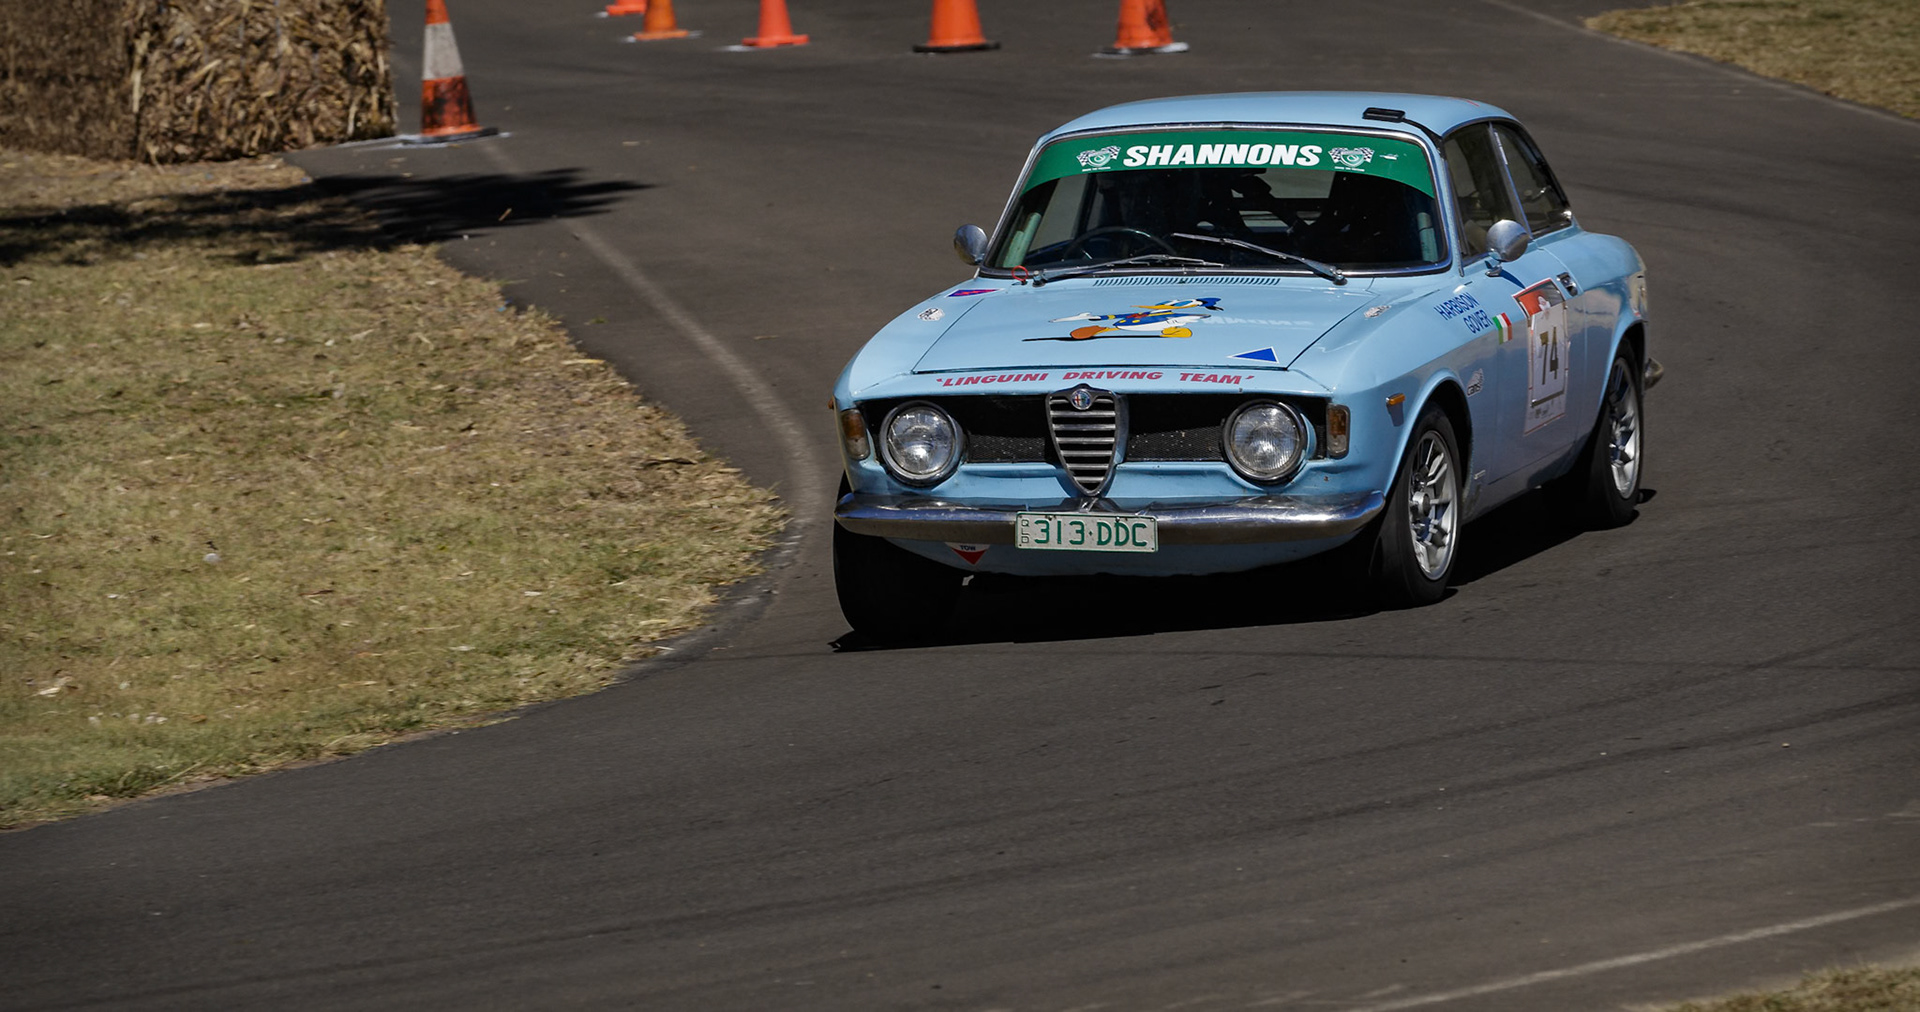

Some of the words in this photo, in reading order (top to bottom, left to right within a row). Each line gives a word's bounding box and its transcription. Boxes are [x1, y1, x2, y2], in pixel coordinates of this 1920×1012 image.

[1123, 144, 1323, 167] SHANNONS
[1433, 291, 1481, 321] HARBISON
[1462, 309, 1494, 334] GOVER
[1539, 326, 1560, 386] 74
[1062, 371, 1163, 380] DRIVING
[1020, 519, 1030, 544] QLD
